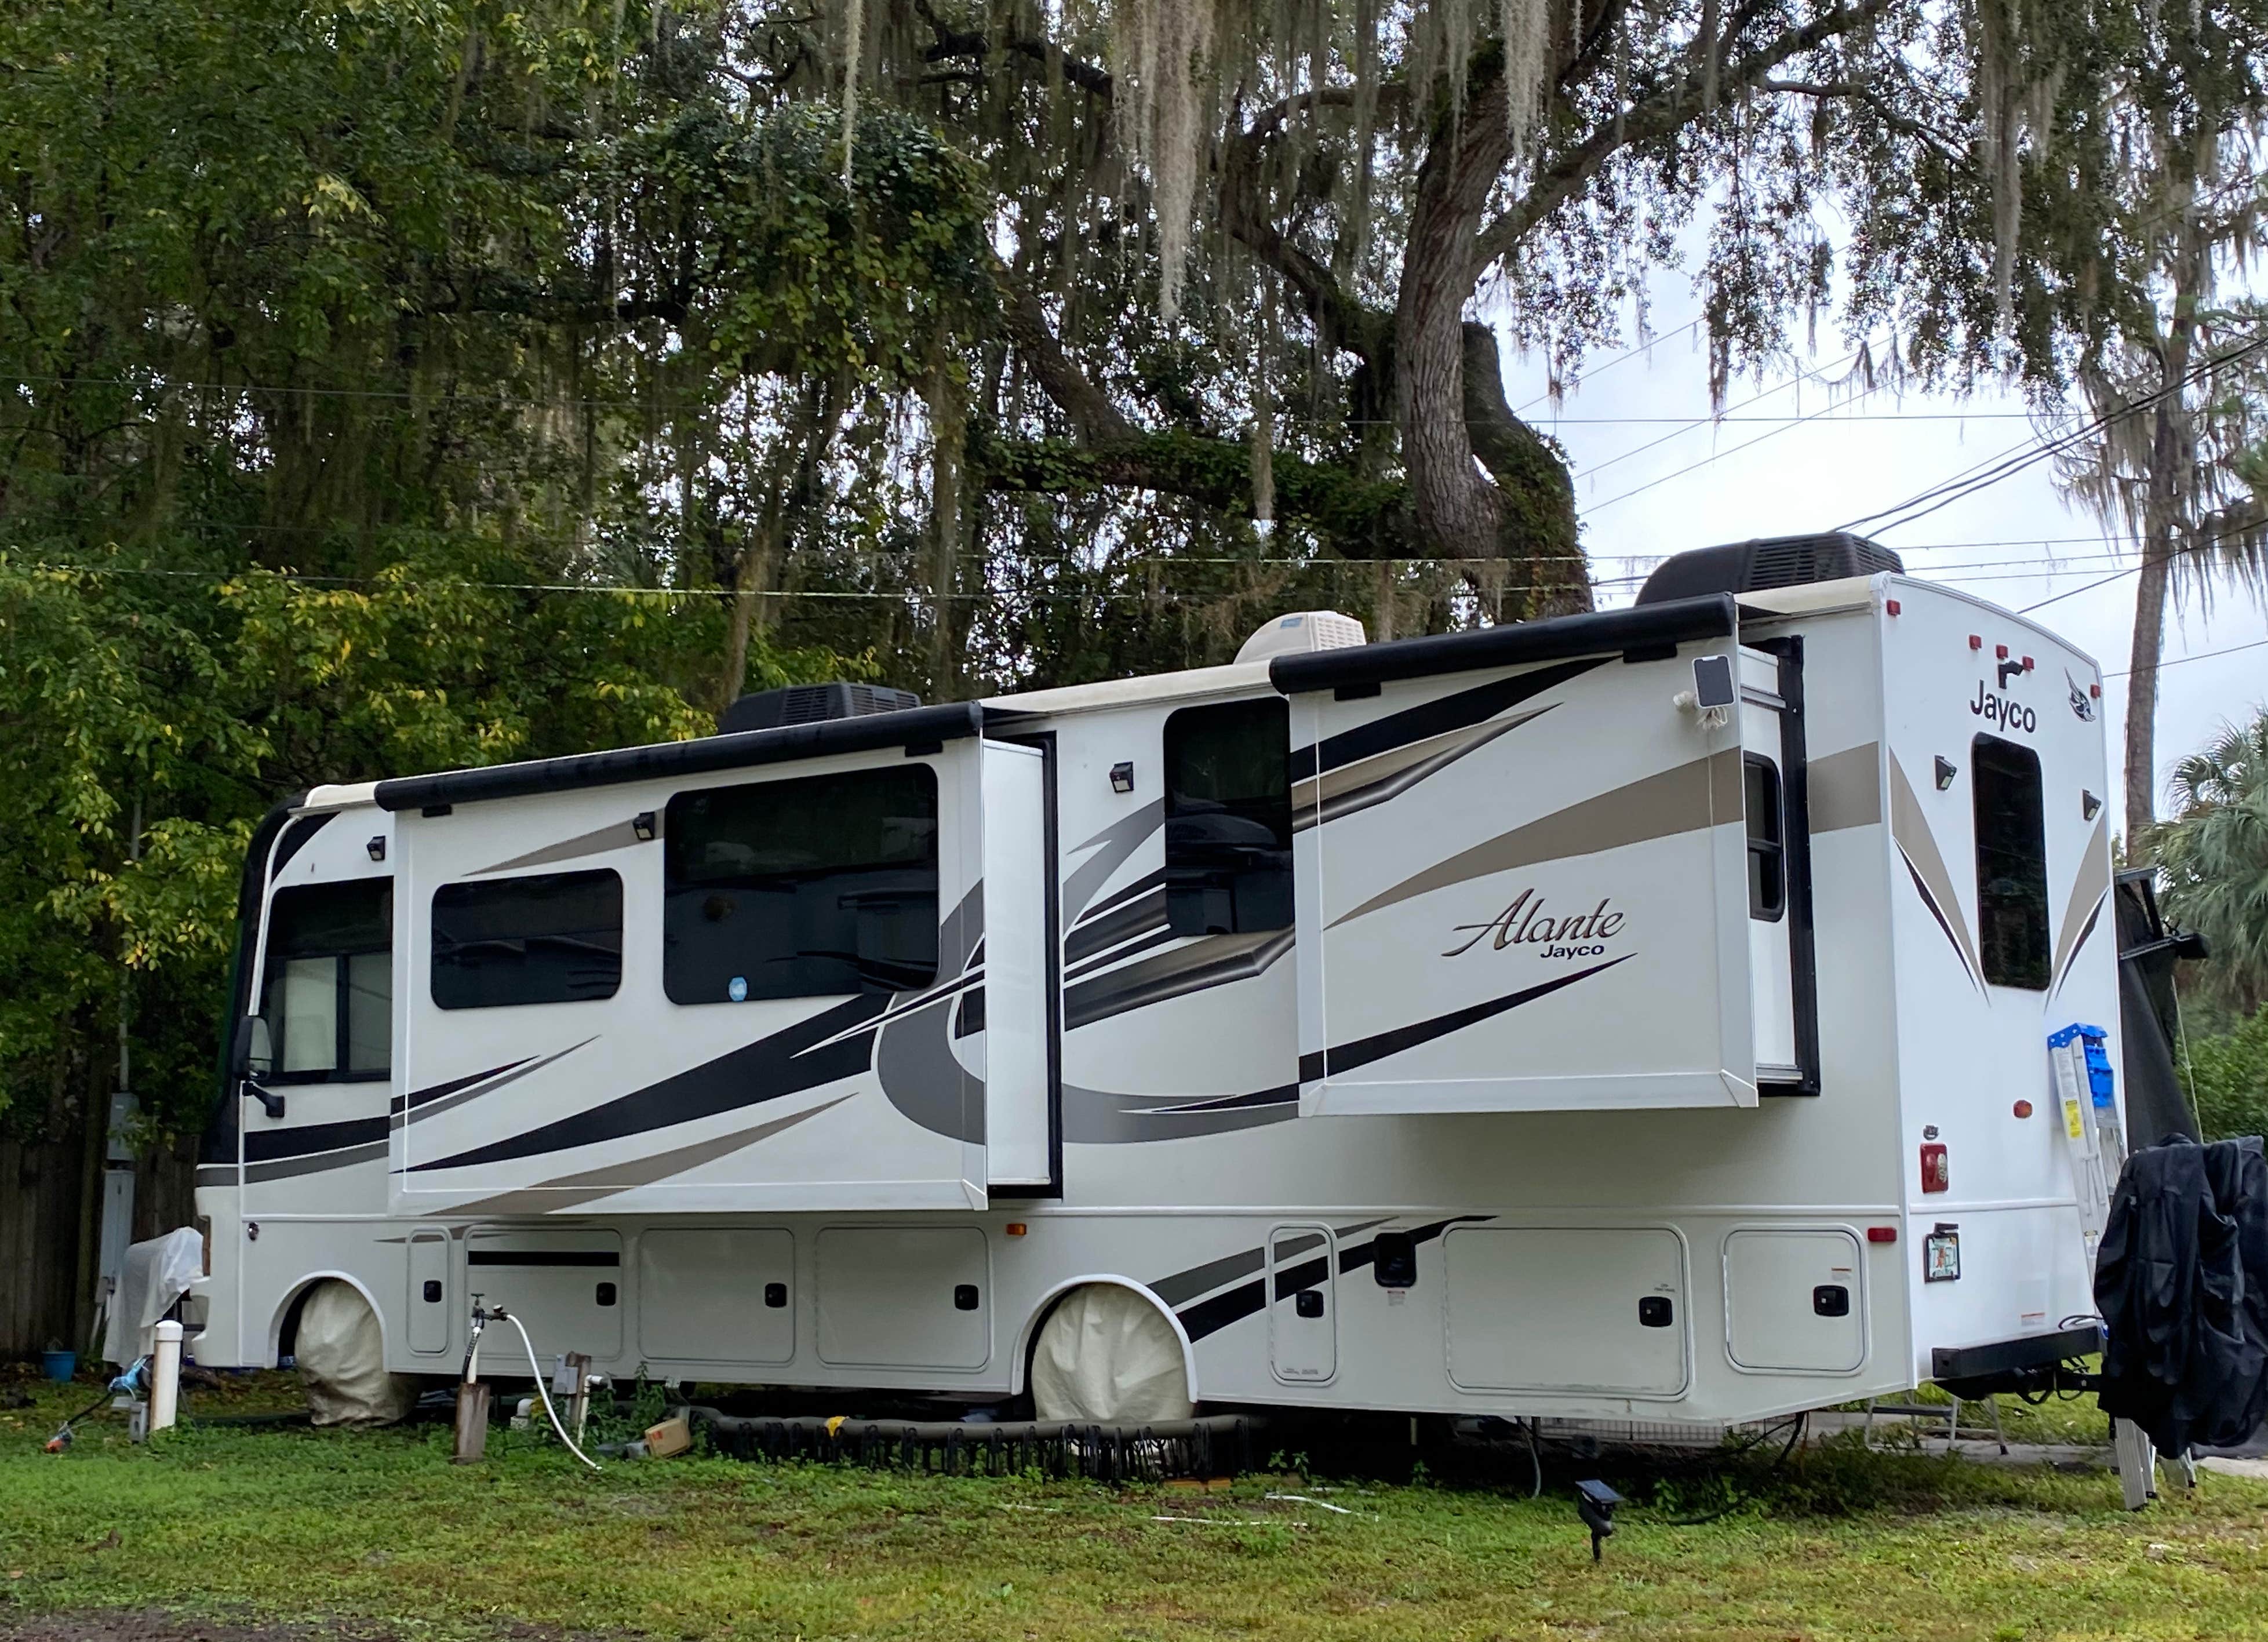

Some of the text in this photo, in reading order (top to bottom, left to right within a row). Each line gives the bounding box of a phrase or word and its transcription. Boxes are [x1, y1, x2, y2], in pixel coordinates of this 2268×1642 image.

[1970, 679, 2036, 733] Jayco
[1441, 888, 1626, 957] Alante
[1540, 944, 1604, 960] Jayco
